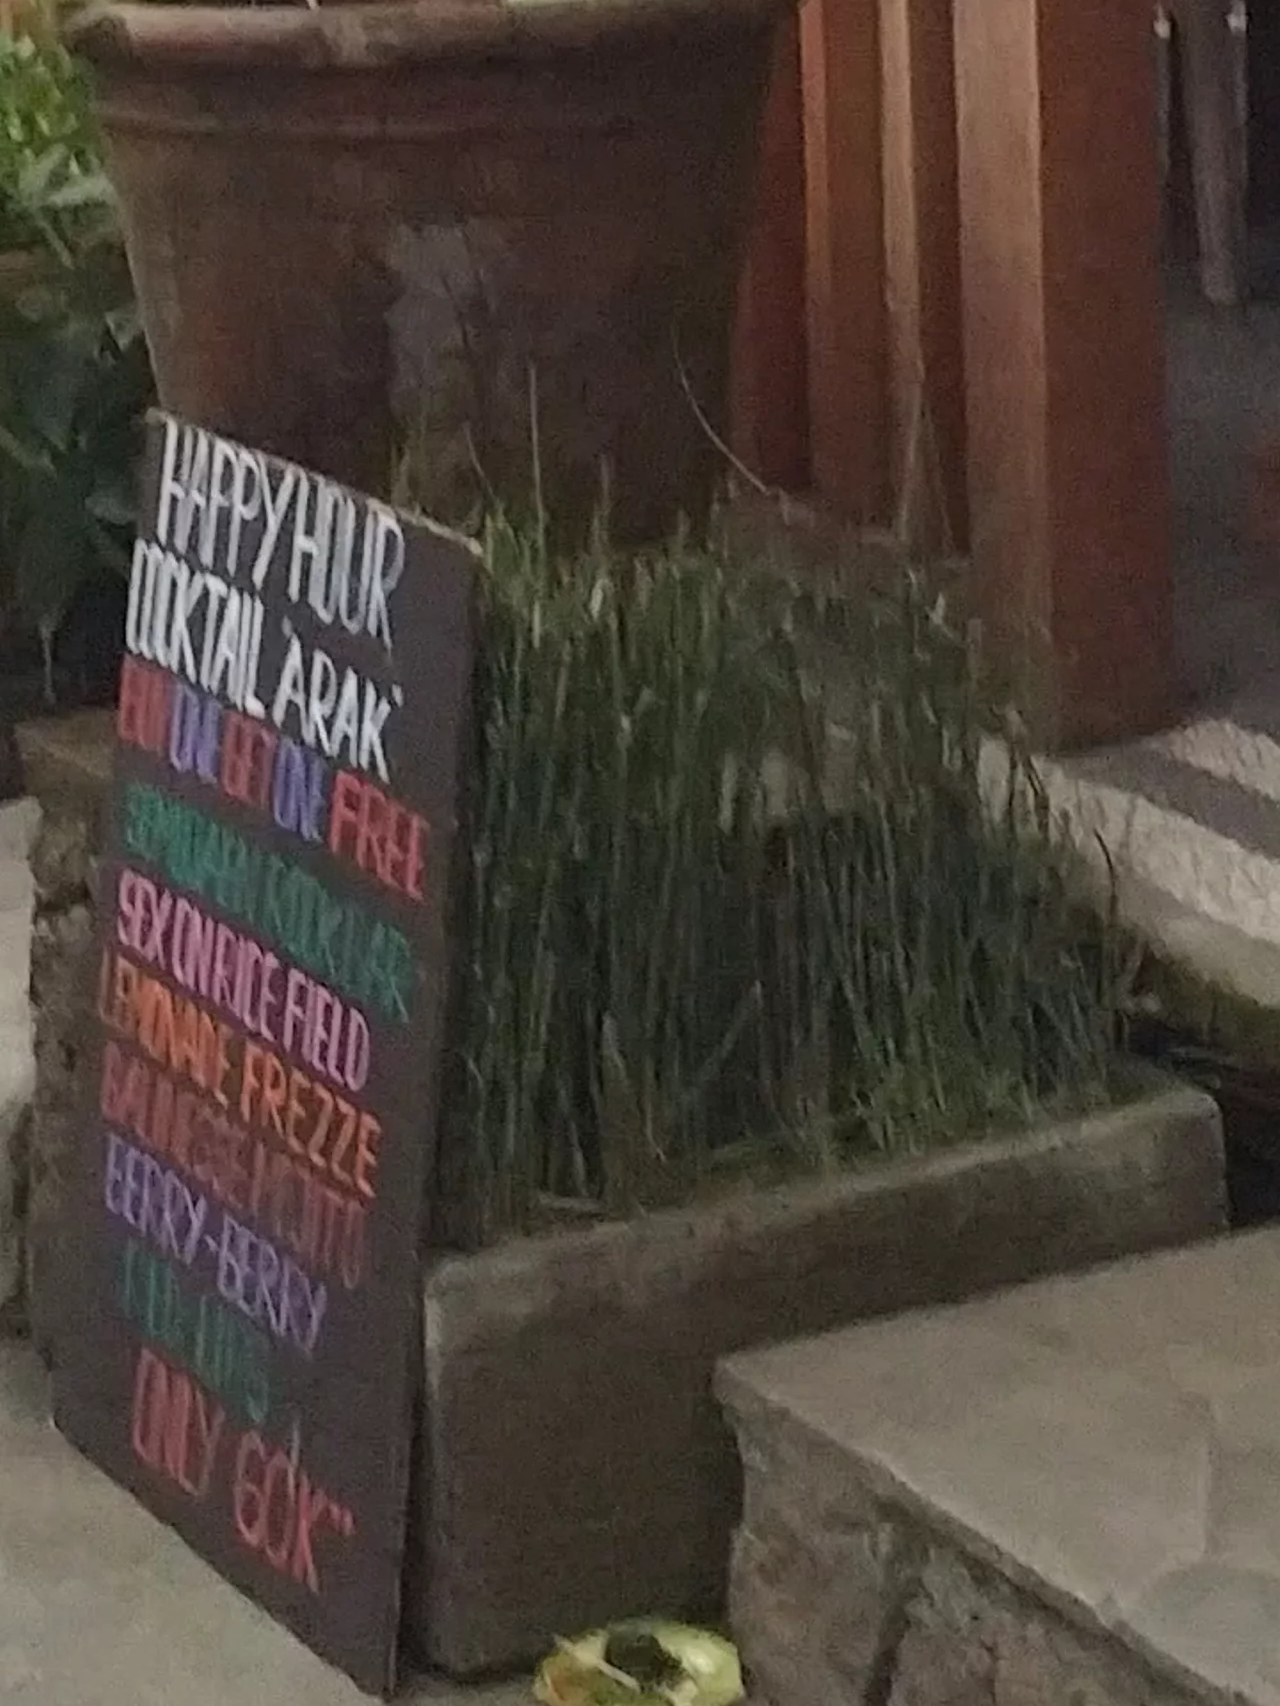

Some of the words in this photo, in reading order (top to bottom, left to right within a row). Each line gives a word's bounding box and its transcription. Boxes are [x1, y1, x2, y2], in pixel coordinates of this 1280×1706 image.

[156, 415, 295, 589] HAPPY
[288, 468, 405, 656] HOUR
[124, 537, 266, 721] COCKTAIL
[328, 768, 431, 903] FREE
[117, 867, 174, 971] SEX
[171, 896, 215, 998] ON
[211, 920, 282, 1044] RICE
[282, 966, 370, 1092] FIELD
[240, 1038, 382, 1199] FREZZE
